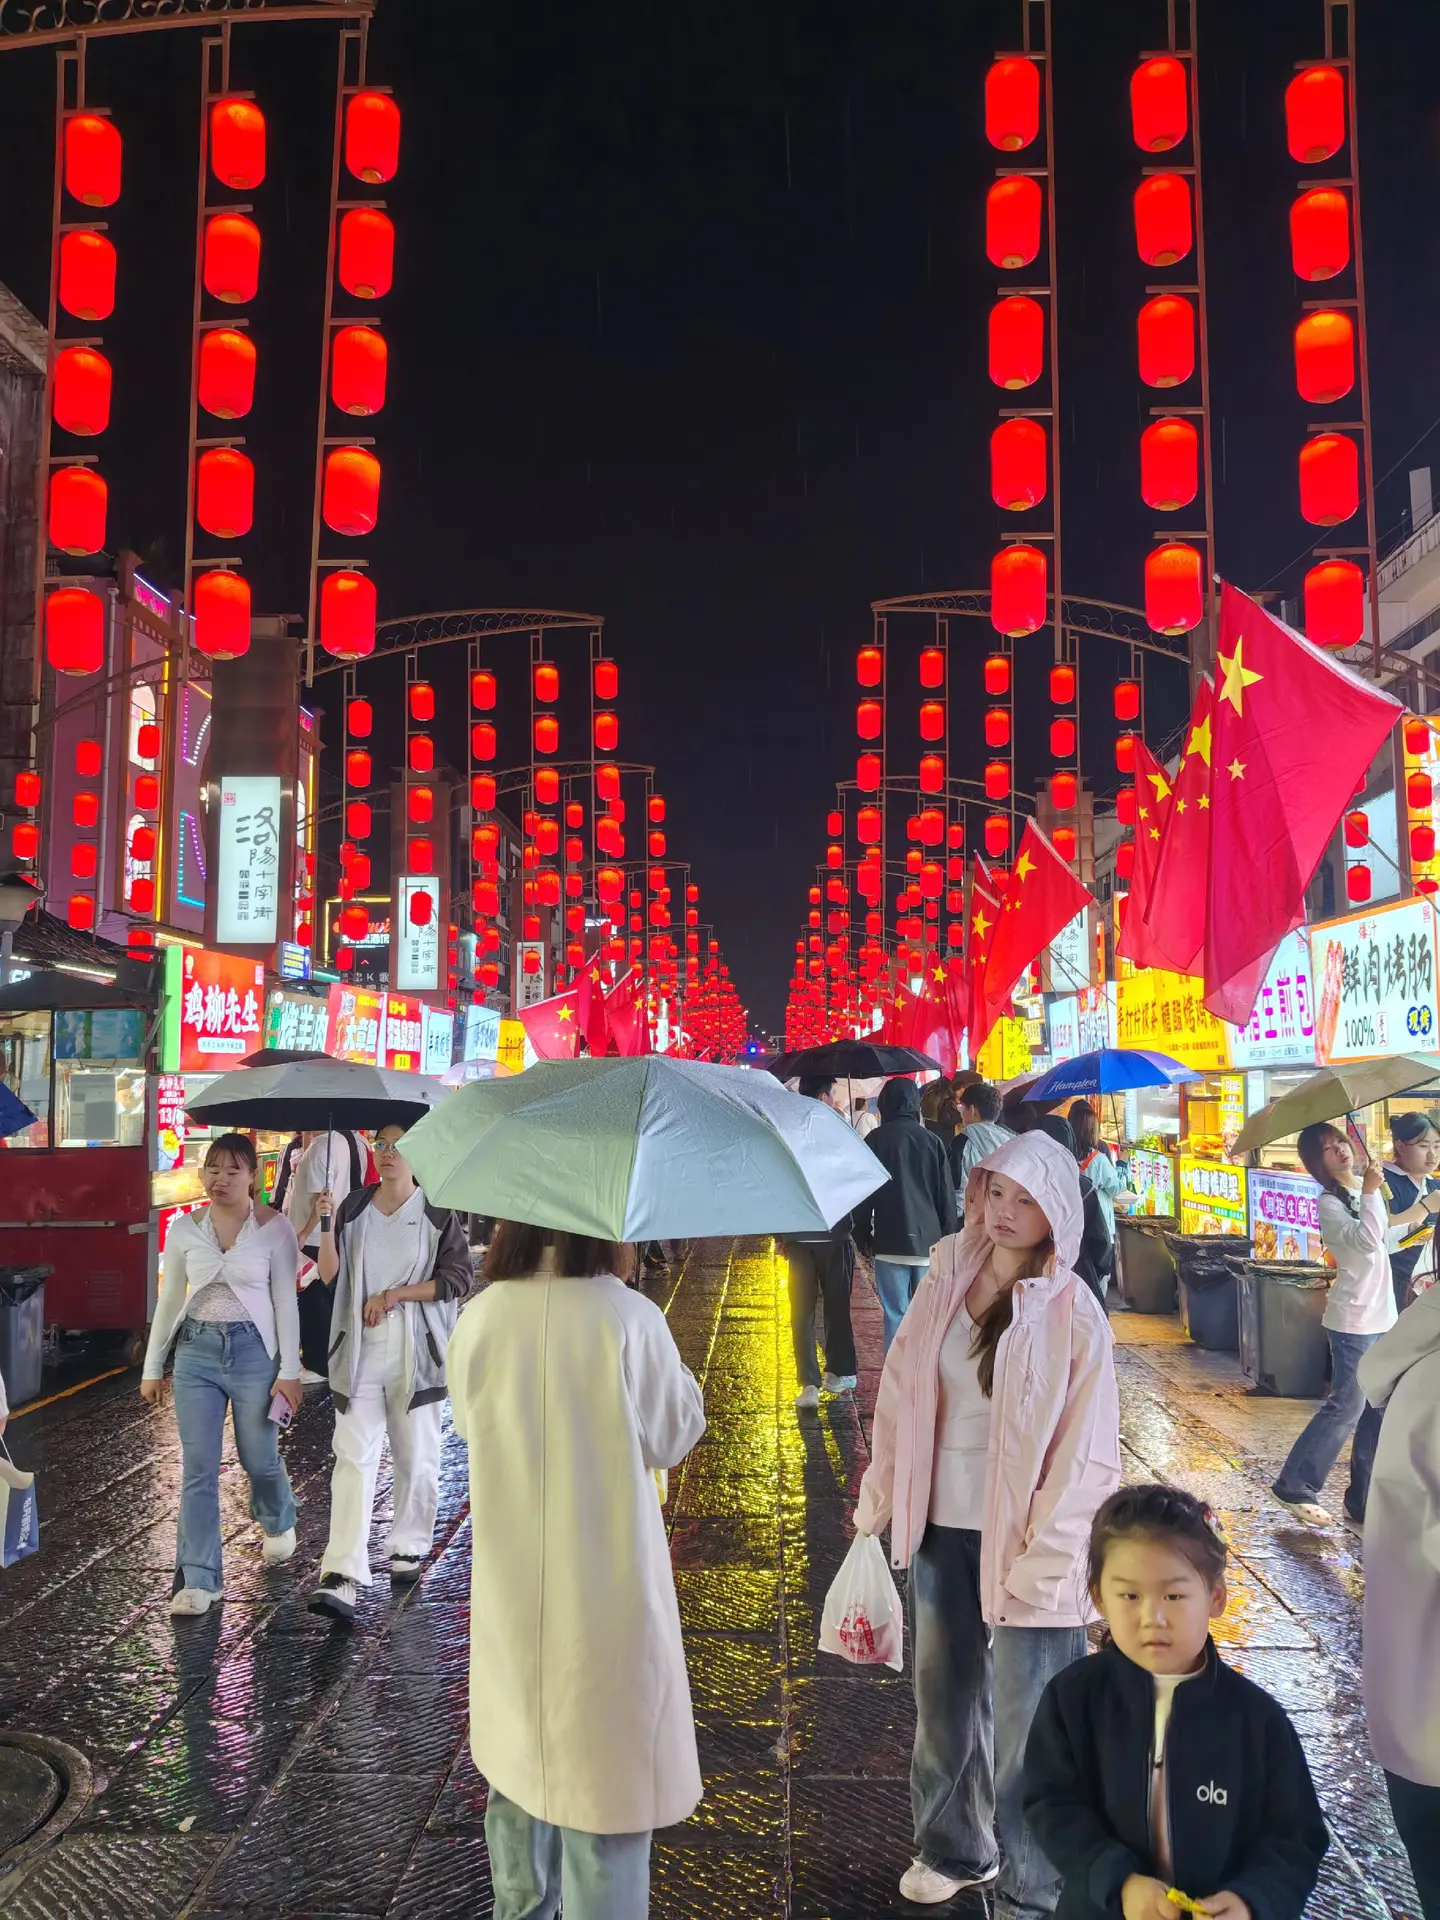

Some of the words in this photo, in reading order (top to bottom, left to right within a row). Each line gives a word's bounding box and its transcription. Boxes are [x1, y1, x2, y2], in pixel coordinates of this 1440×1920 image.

[1342, 932, 1432, 1006] 鲜肉烤肠
[183, 981, 260, 1034] 鸡柳先生
[1234, 965, 1314, 1045] 指生煎包
[1345, 1015, 1375, 1048] 100%
[1196, 1780, 1227, 1806] ola
